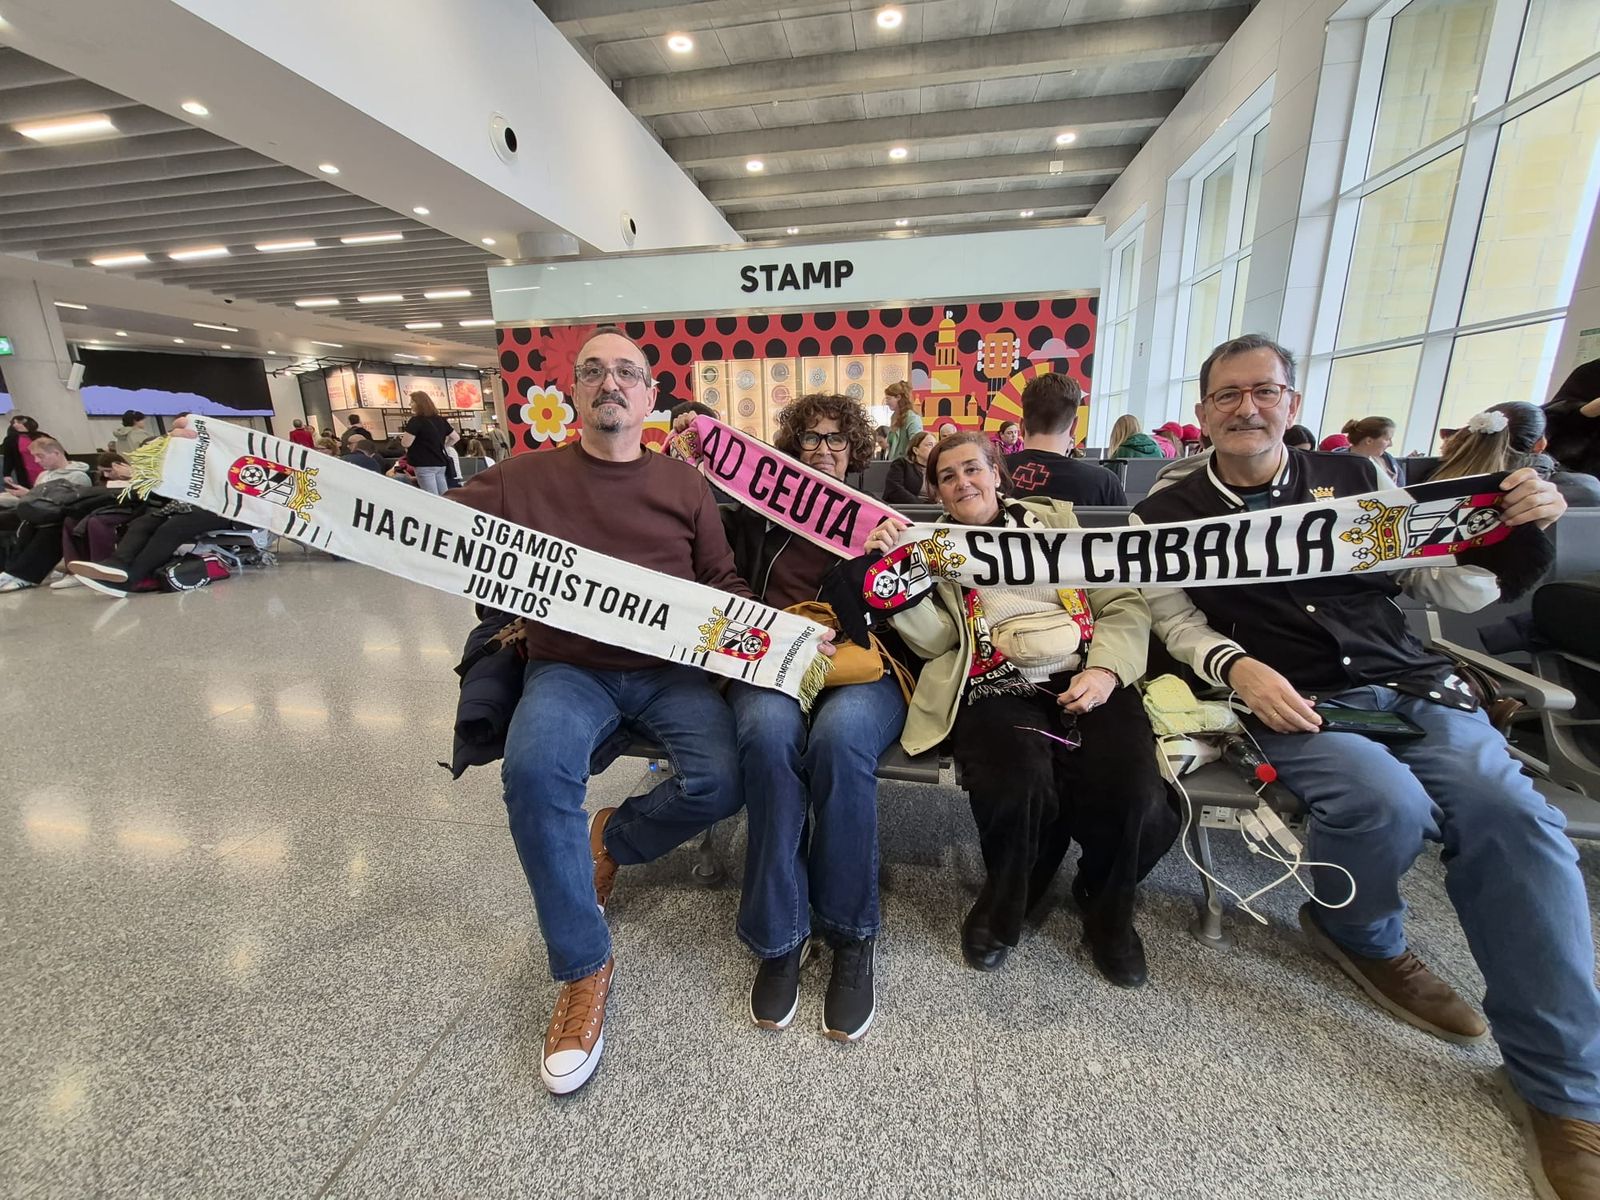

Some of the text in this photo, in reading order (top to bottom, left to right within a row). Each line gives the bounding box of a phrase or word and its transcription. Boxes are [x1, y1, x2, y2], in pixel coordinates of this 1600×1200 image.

[740, 259, 854, 293] STAMP
[702, 425, 862, 548] AD CEUTA
[351, 497, 670, 631] HACIENDO HISTORIA
[471, 514, 578, 568] SIGAMOS
[965, 508, 1338, 586] SOY CABALLA
[463, 573, 552, 619] JUNTOS
[985, 661, 1017, 680] CEUTA
